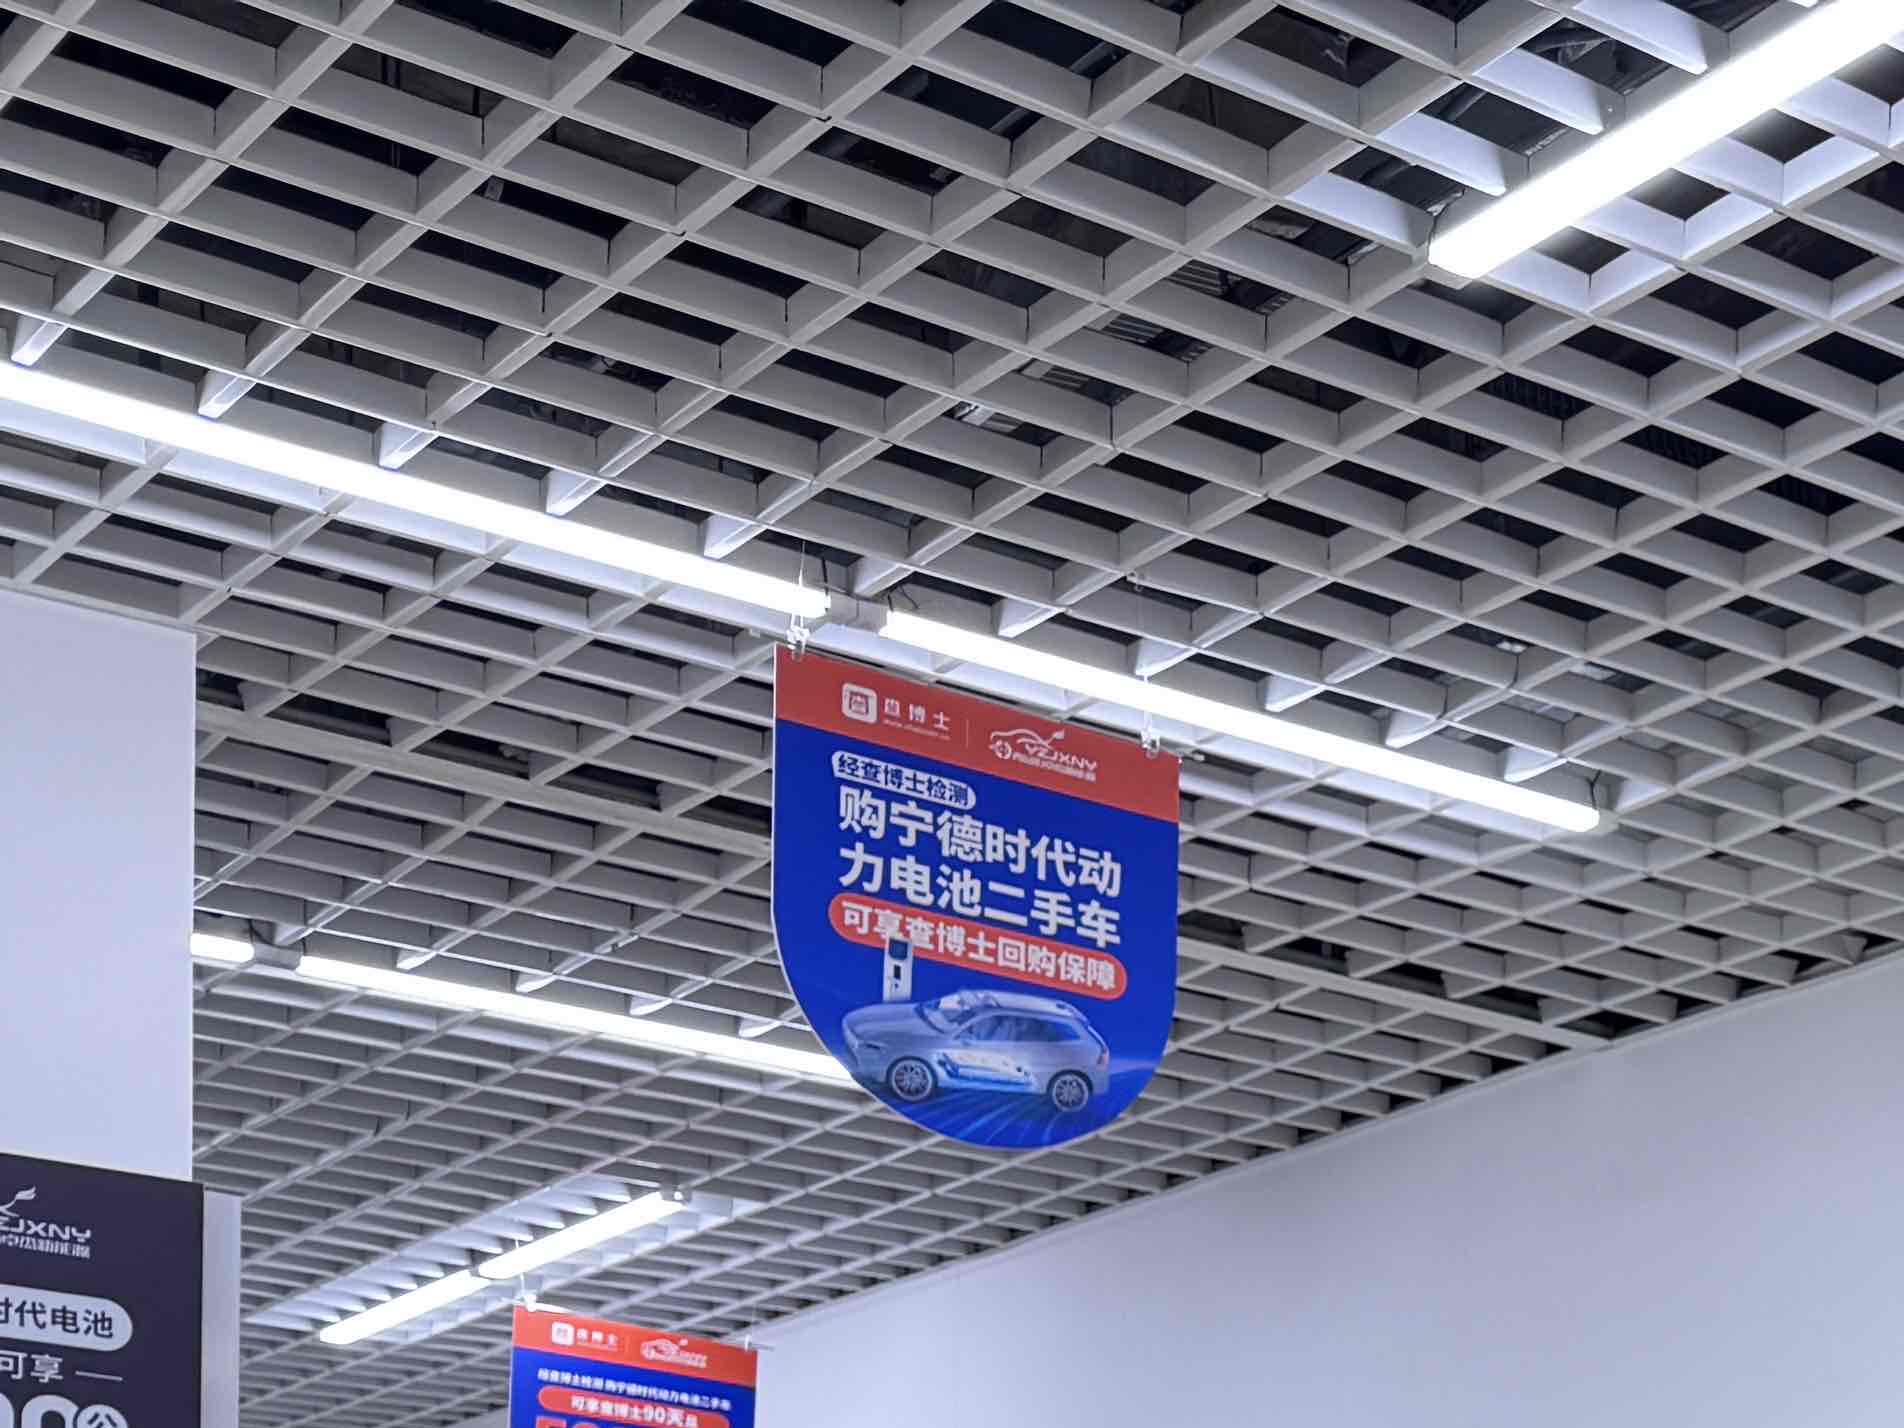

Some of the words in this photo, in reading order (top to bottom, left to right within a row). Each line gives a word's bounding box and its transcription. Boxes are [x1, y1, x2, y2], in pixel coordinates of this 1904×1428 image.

[837, 753, 969, 807] 经查博士检测
[839, 785, 1122, 898] 购宁德时代动
[839, 841, 1121, 949] 力电池二手车
[841, 900, 1118, 992] 可享查博士回购保障
[0, 1352, 64, 1383] 可享
